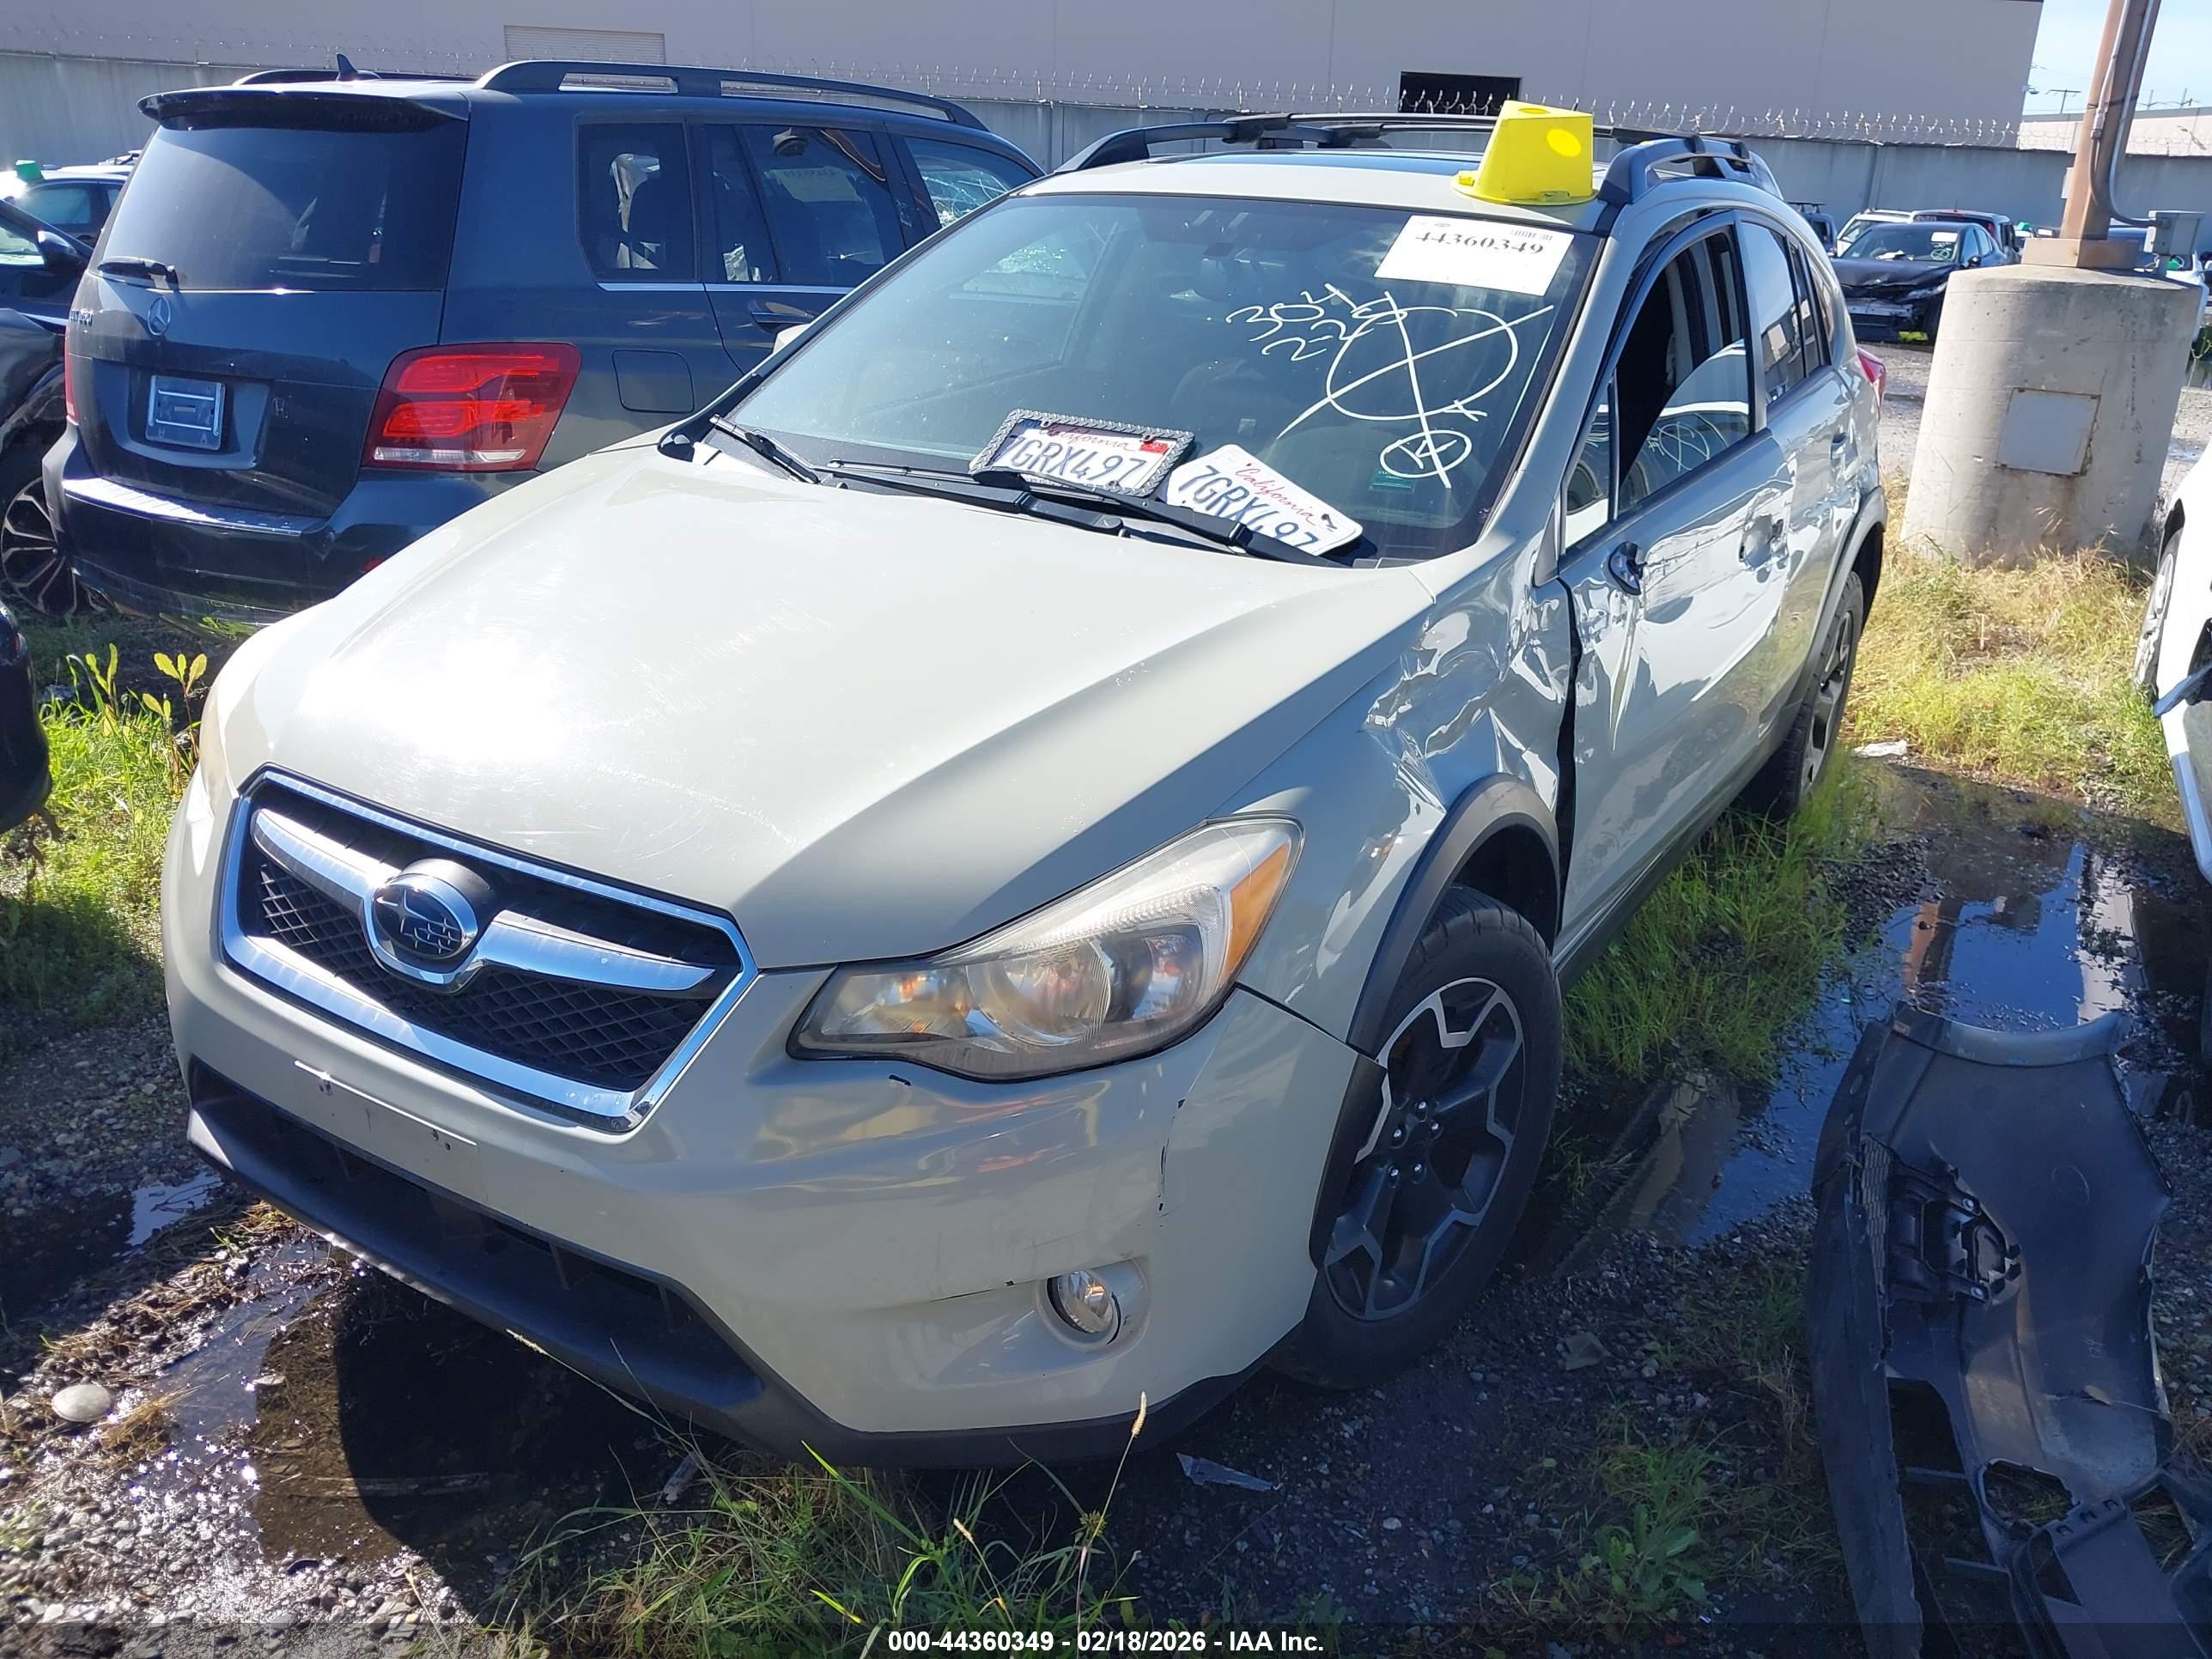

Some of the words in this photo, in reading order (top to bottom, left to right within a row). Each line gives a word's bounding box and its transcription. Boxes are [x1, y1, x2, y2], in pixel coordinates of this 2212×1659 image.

[1414, 231, 1545, 255] 44360349
[1038, 424, 1136, 453] California
[991, 436, 1147, 486] 7GRX497
[1235, 467, 1316, 526] California
